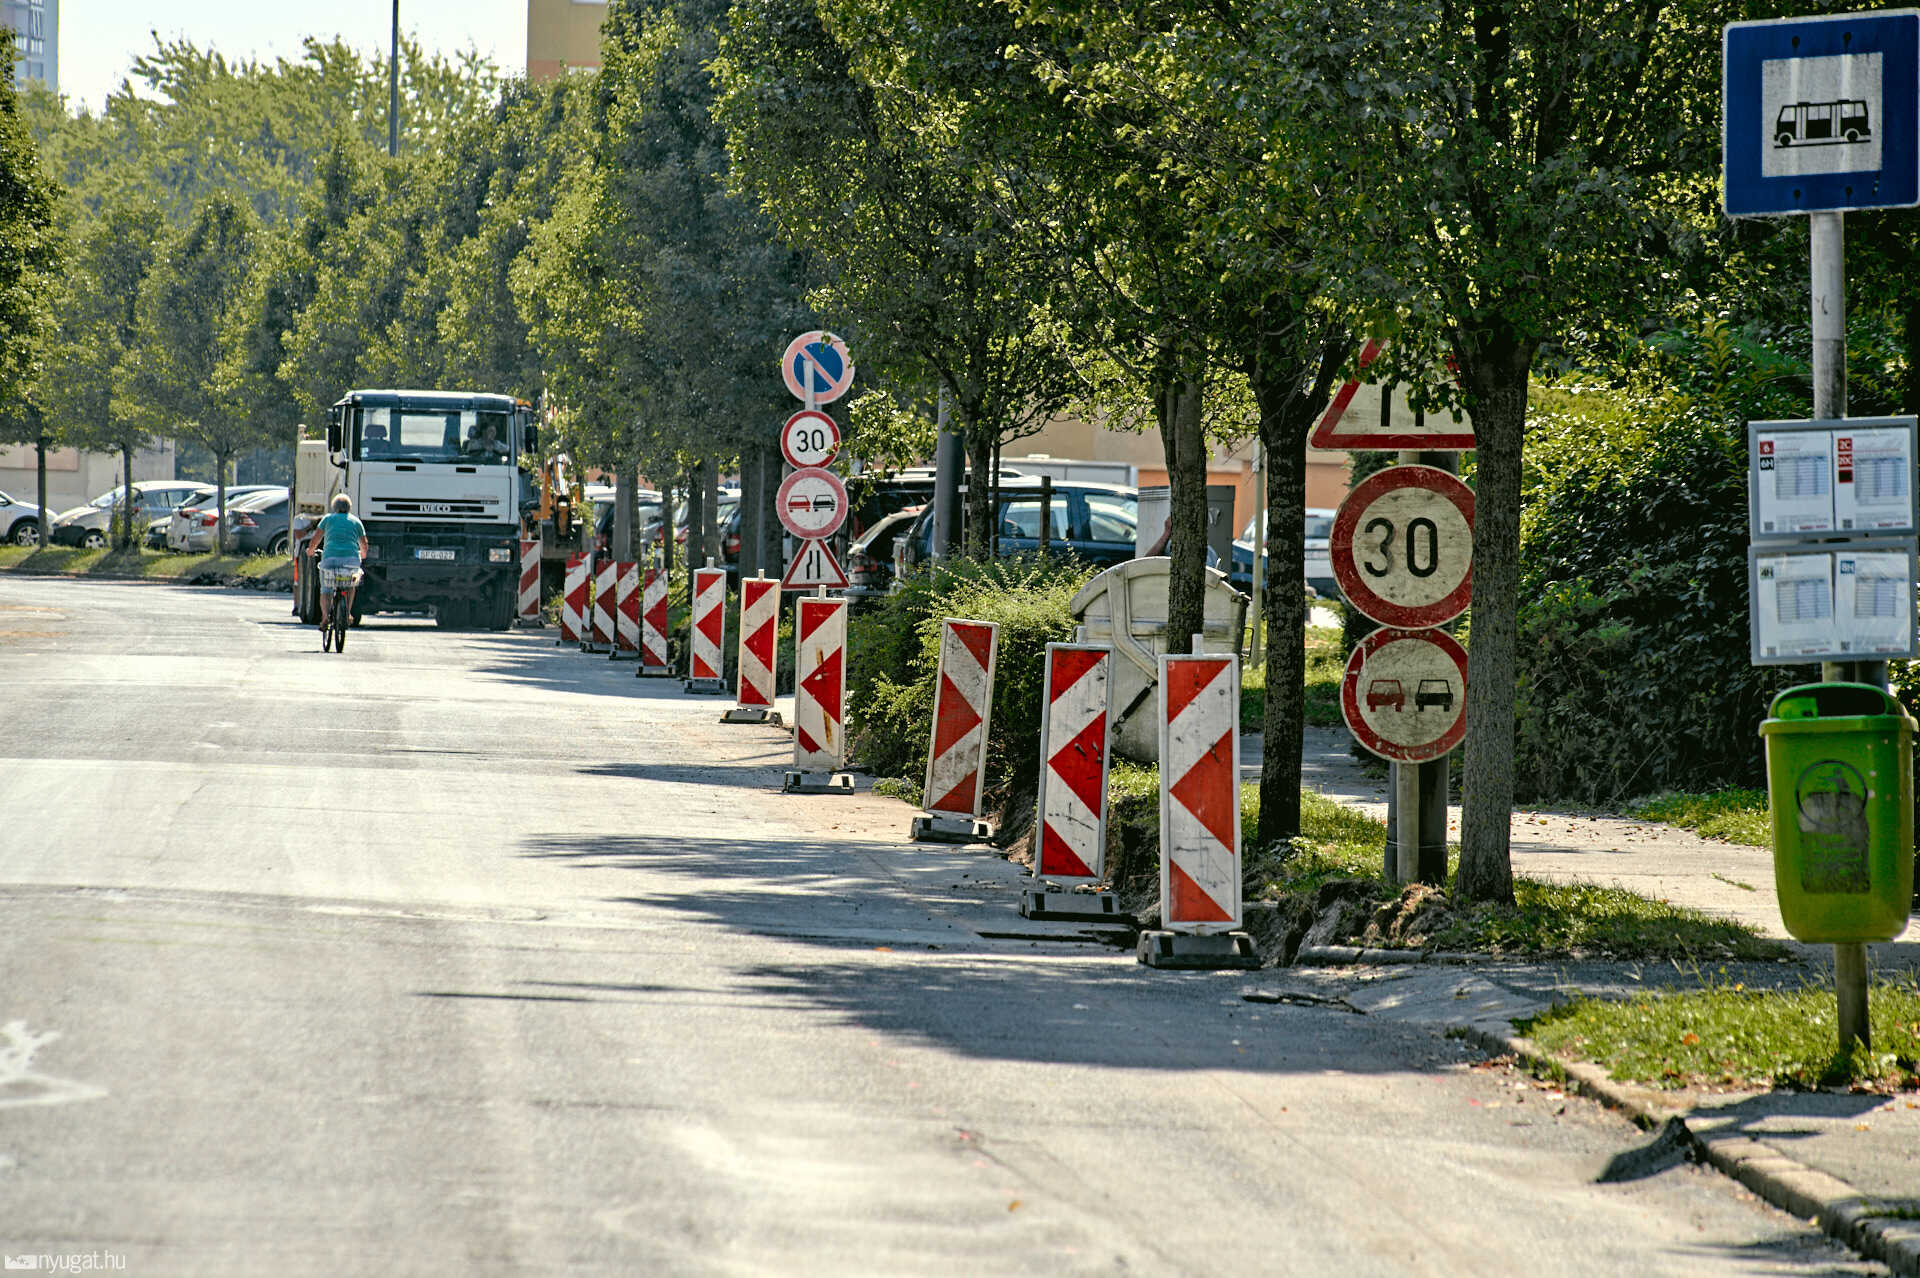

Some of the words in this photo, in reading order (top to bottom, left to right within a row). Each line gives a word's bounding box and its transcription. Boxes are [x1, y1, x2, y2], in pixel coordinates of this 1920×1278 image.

[796, 430, 824, 453] 30
[420, 504, 451, 513] IVECO
[1364, 516, 1438, 578] 30
